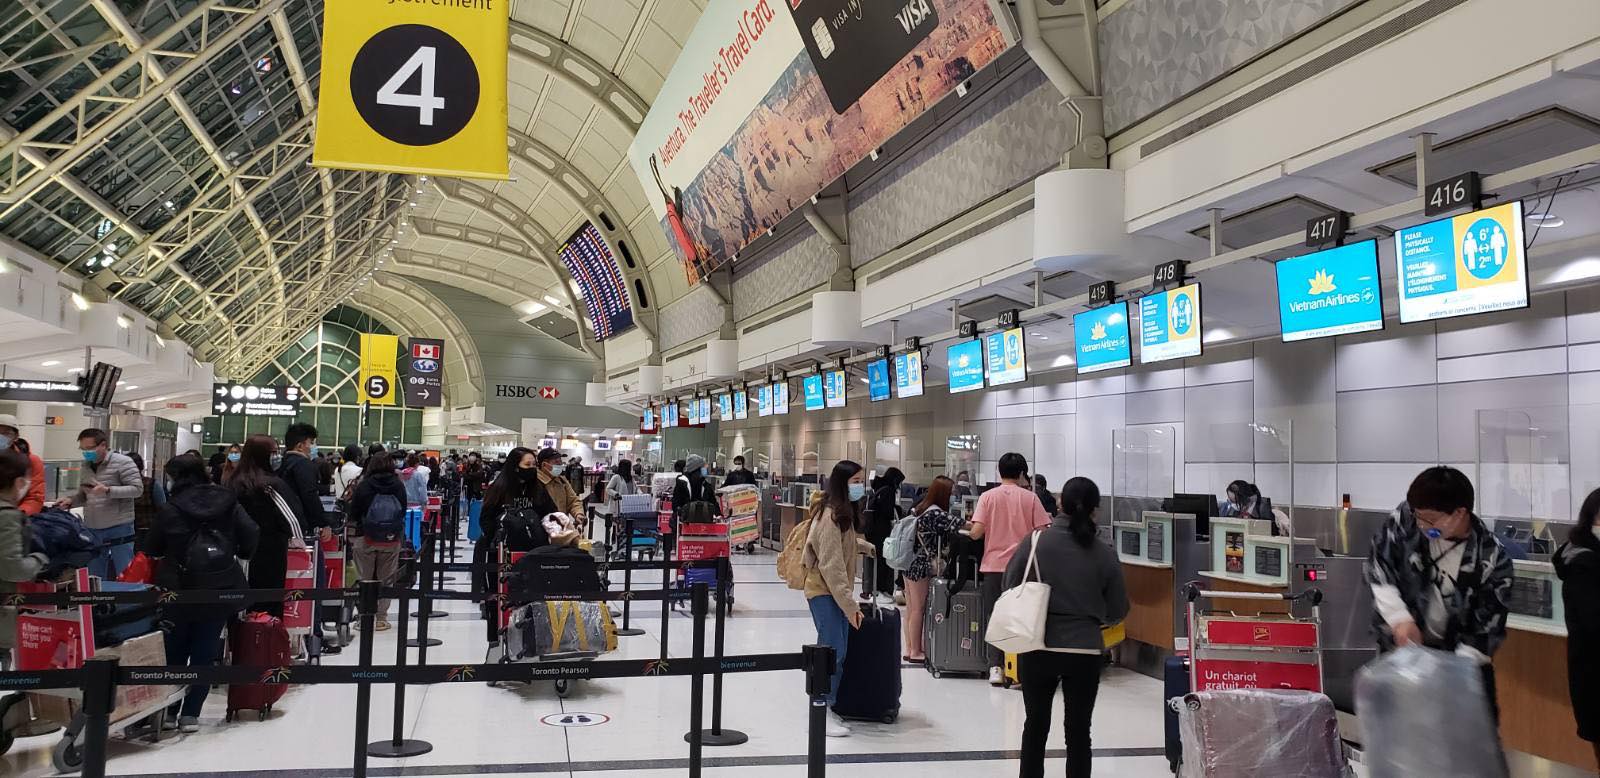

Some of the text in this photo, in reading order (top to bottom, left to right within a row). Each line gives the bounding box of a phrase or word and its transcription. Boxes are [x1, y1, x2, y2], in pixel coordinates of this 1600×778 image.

[831, 9, 849, 31] VISA
[894, 0, 932, 35] VISA
[376, 45, 445, 126] 4
[658, 0, 776, 168] Aventura. The Traveller's Travel Card.
[1430, 179, 1466, 208] 416
[1310, 217, 1336, 240] 417
[1156, 264, 1175, 281] 418
[1090, 285, 1106, 300] 419
[1289, 293, 1360, 313] Vietnam Airlines
[998, 311, 1013, 325] 420
[960, 322, 971, 335] 421
[1081, 339, 1119, 353] Vietnam Airlines
[370, 378, 384, 395] 5
[495, 385, 537, 399] HSBC
[531, 666, 589, 676] Toronto Pearson
[720, 659, 757, 669] bienvenue
[130, 671, 198, 680] Toronto Pearson
[352, 670, 389, 679] welcome
[1205, 670, 1257, 682] Un chariot
